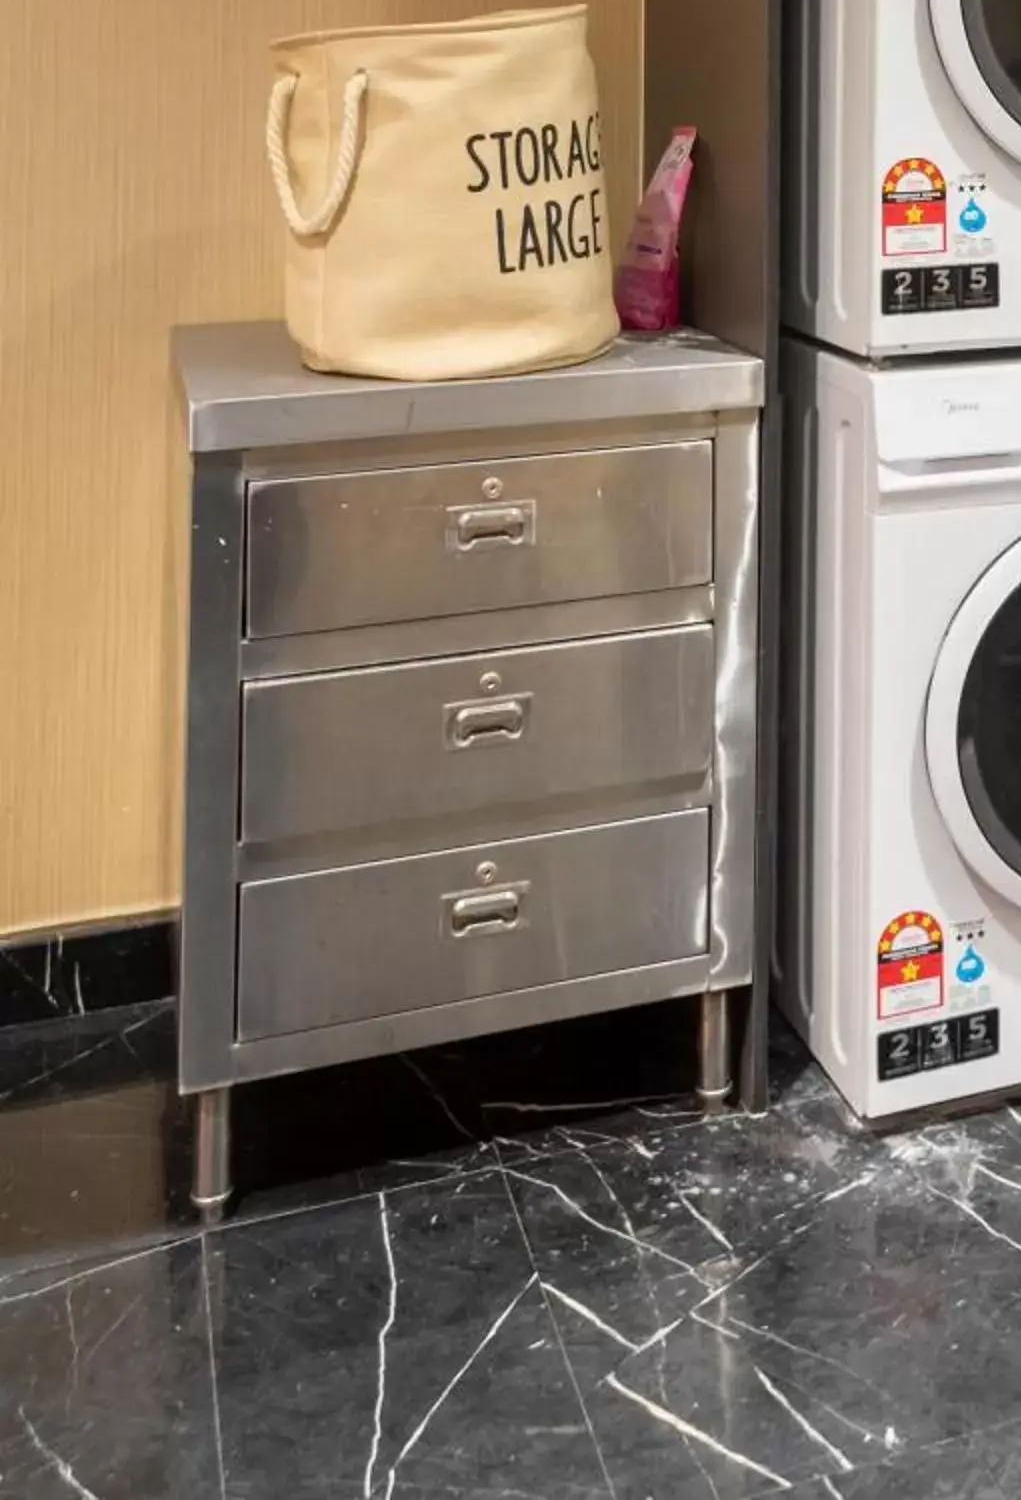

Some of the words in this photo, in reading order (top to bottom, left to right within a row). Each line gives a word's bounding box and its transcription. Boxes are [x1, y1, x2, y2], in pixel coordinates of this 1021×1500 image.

[496, 189, 602, 274] LARGE
[894, 271, 912, 295] 2
[932, 269, 950, 292] 3
[970, 266, 987, 290] 5
[889, 1033, 910, 1059] 2
[930, 1022, 949, 1048] 3
[969, 1014, 987, 1040] 5
